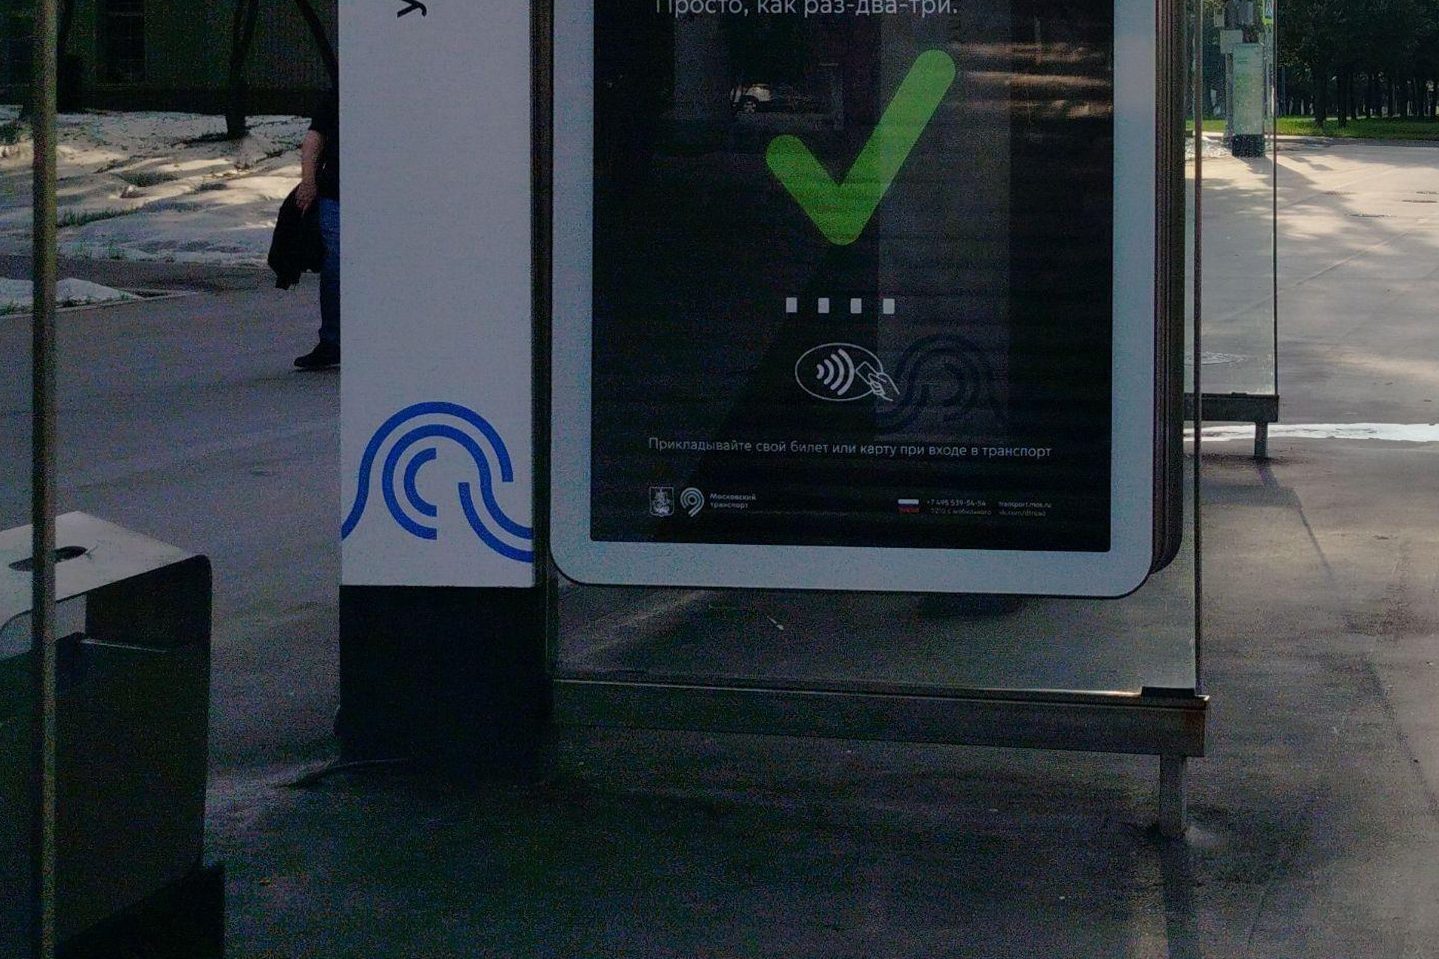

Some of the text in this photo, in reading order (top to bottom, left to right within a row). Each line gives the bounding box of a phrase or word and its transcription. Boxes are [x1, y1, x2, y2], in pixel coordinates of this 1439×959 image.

[649, 437, 1051, 460] Прикладывайте свой билет или карту при входе в транспорт
[709, 492, 757, 501] Московский
[710, 502, 749, 510] транспорт
